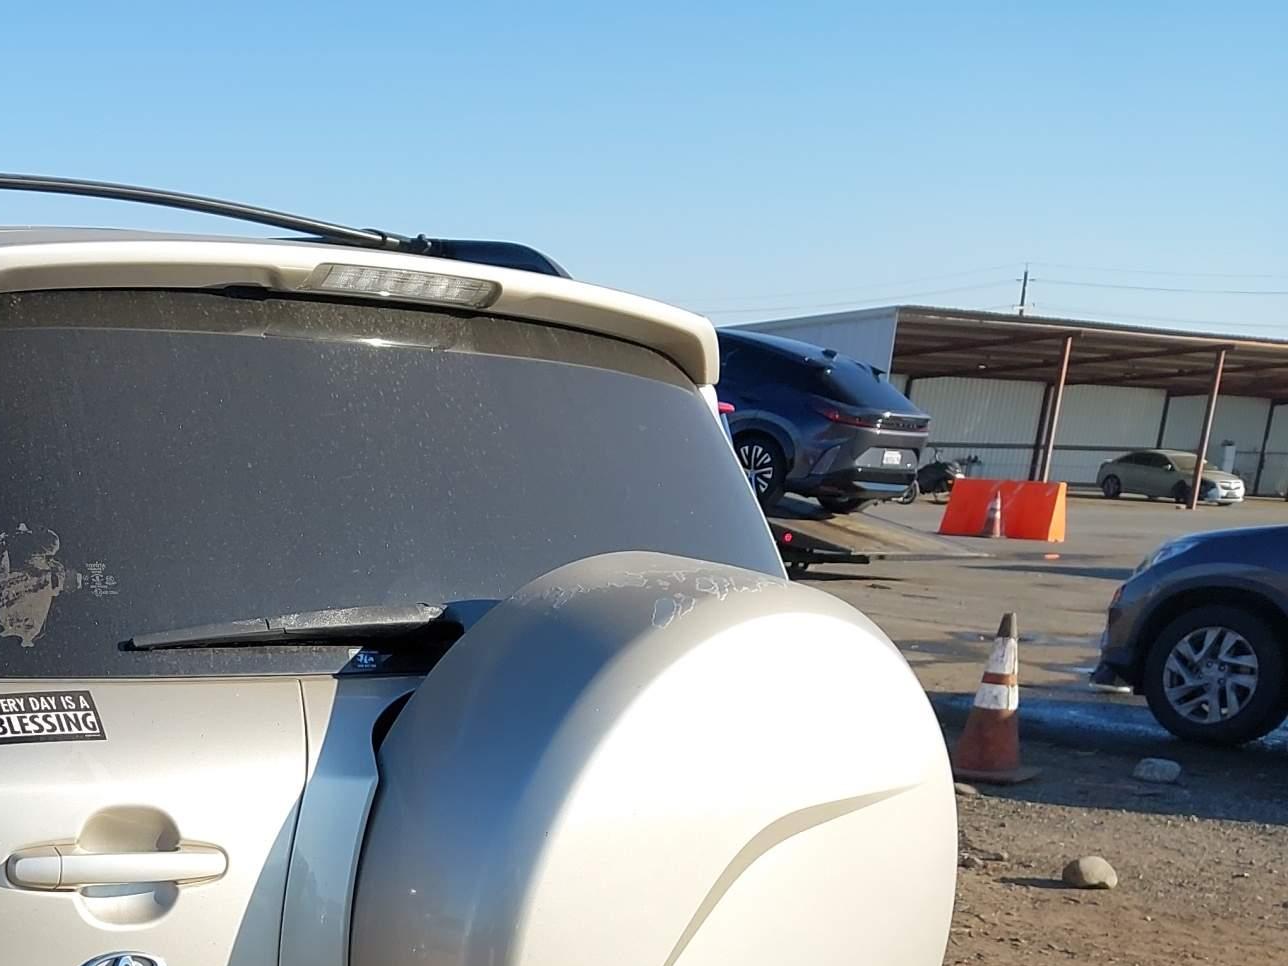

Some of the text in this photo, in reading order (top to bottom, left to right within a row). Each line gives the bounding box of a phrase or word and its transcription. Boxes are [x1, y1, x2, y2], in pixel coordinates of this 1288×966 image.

[28, 695, 57, 710] DAY
[60, 695, 76, 710] IS
[79, 695, 90, 709] A
